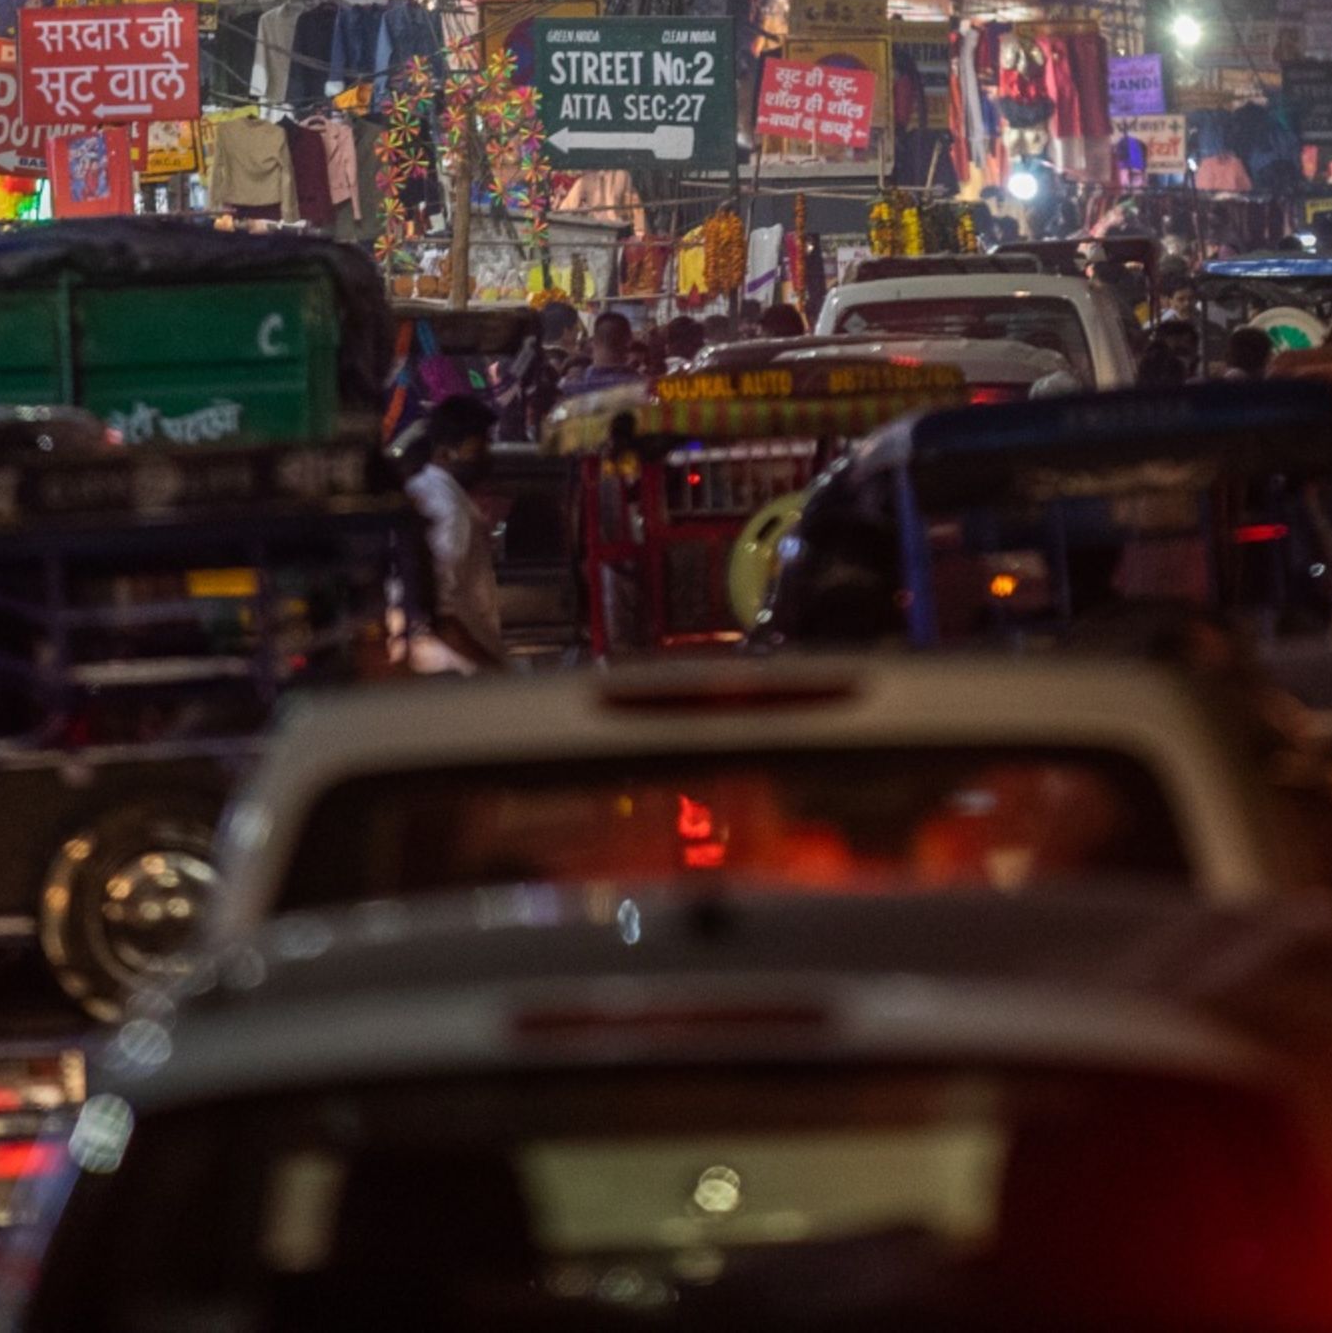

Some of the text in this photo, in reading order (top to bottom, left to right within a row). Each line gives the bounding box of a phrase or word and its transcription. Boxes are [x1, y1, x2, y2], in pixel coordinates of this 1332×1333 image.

[33, 7, 183, 53] सरदार जी
[31, 65, 100, 117] सूट
[104, 51, 189, 103] वाले
[549, 50, 715, 87] STREET No:2
[559, 93, 706, 122] ATTA SEC:27
[257, 312, 288, 357] C
